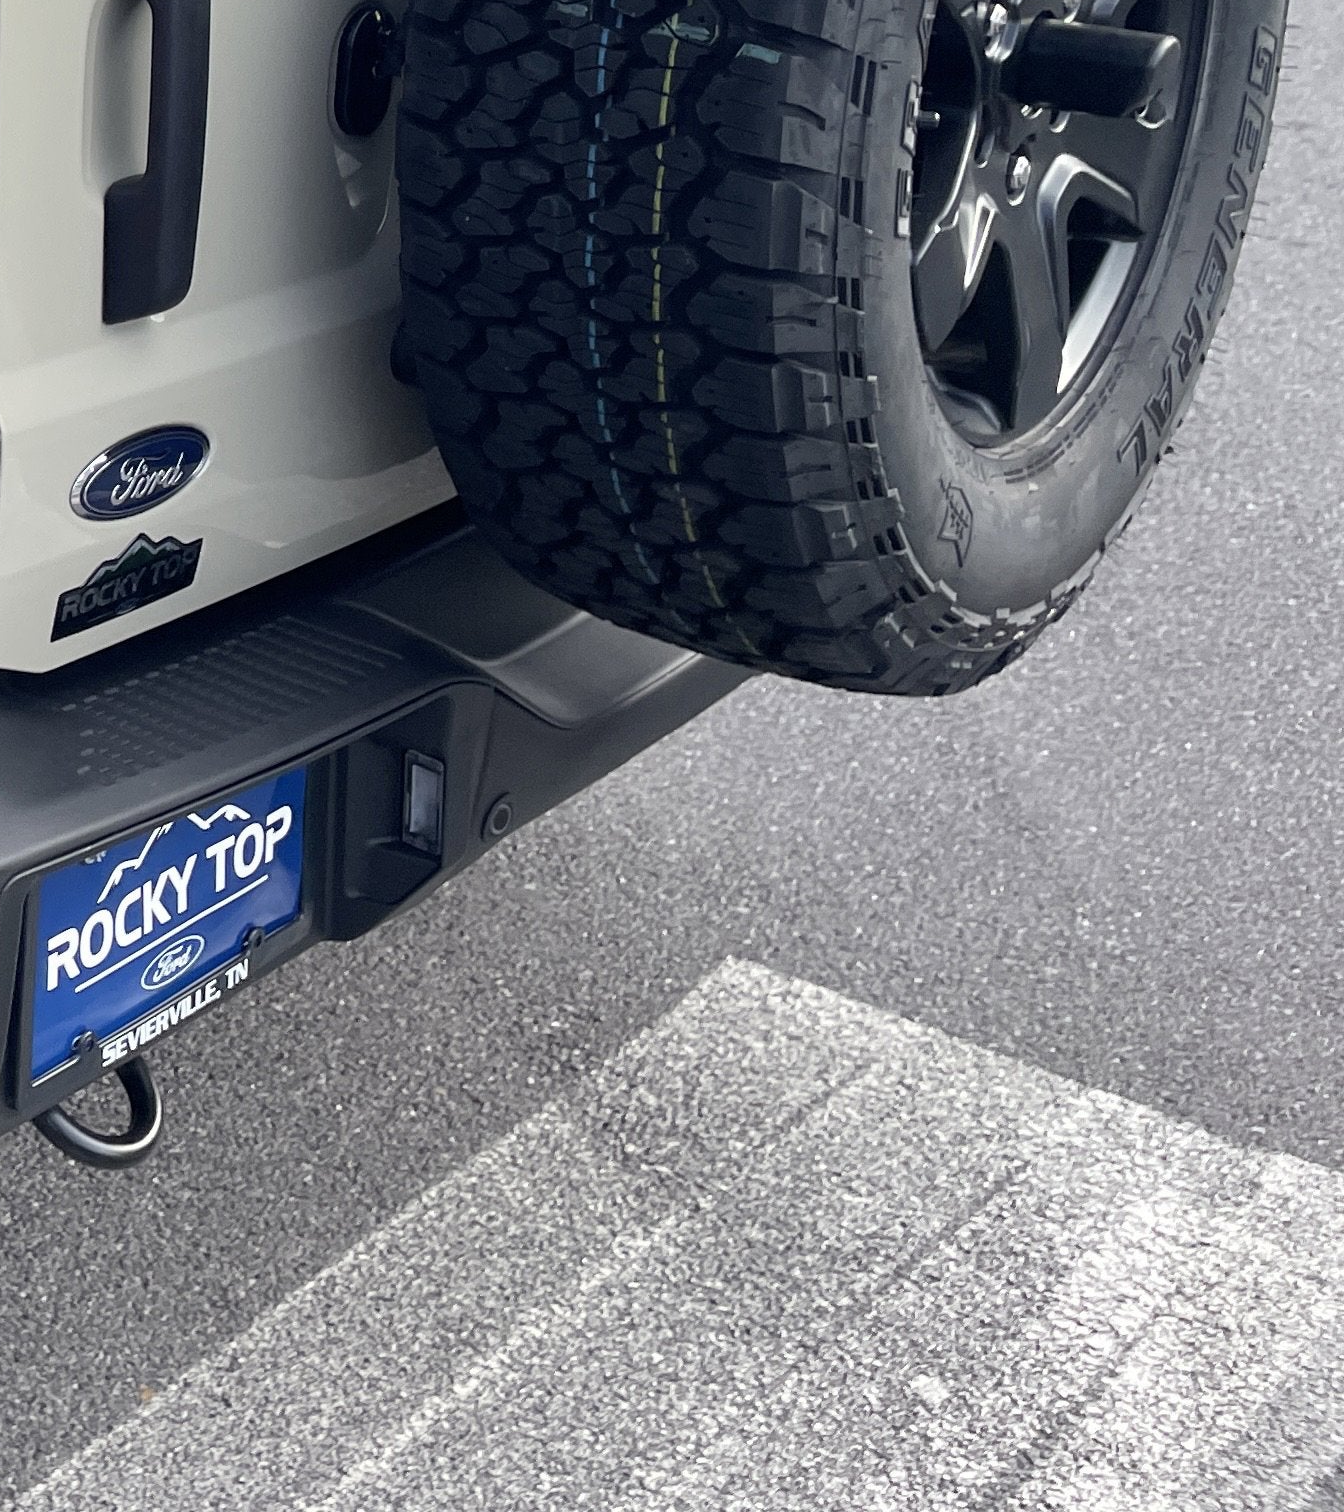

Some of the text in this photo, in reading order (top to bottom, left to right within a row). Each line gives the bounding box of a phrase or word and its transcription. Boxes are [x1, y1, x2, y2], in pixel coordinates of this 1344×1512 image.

[1117, 24, 1278, 478] GENERAL
[111, 451, 184, 506] Ford
[61, 543, 200, 622] ROCKY TOP
[47, 805, 293, 992] ROCKY TOP
[153, 944, 193, 983] Ford
[225, 959, 250, 990] TN
